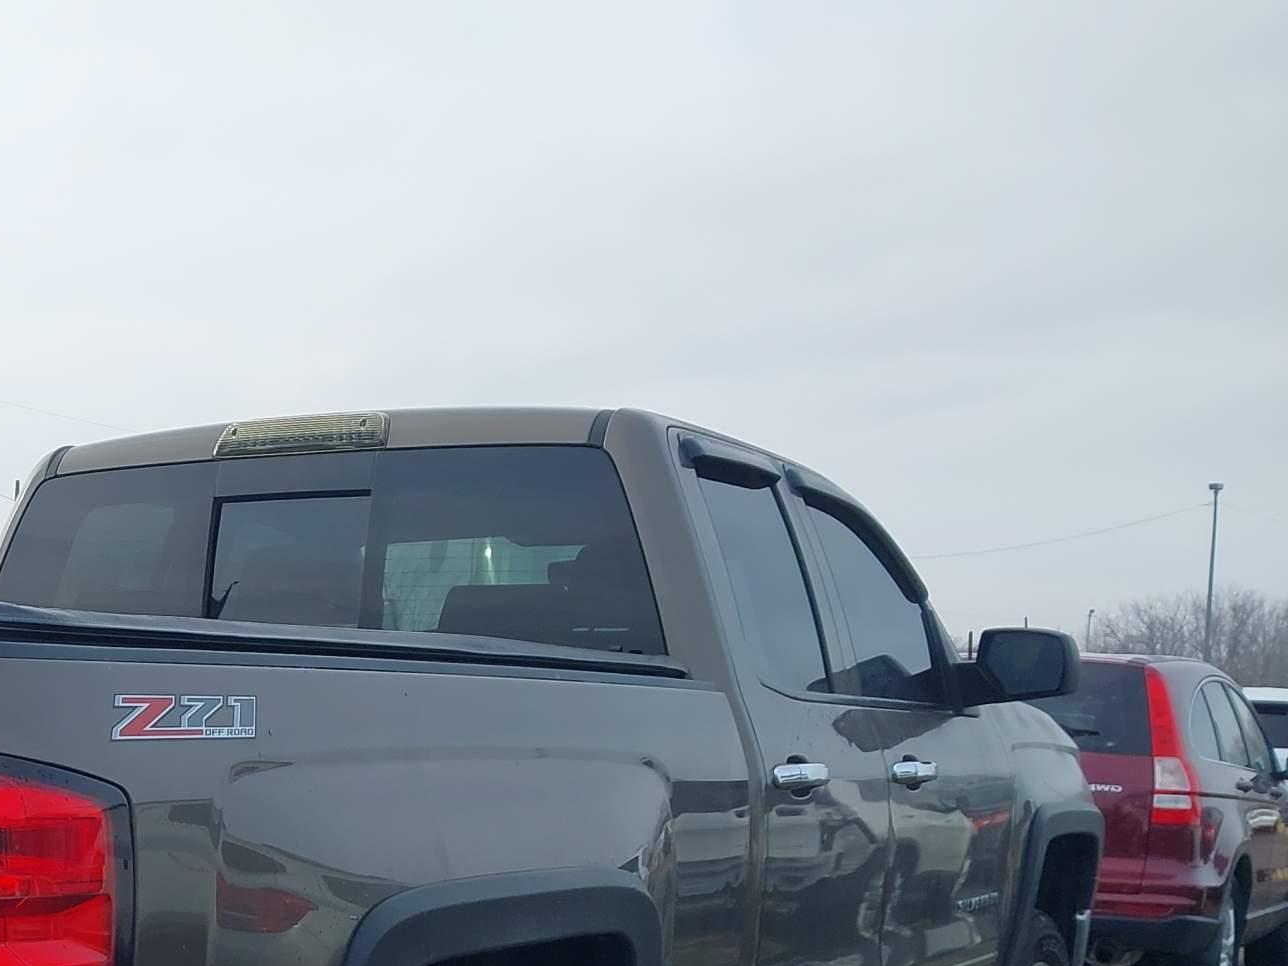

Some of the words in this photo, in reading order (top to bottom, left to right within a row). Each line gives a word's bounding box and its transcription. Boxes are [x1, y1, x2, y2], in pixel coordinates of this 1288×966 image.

[111, 693, 258, 740] Z71
[204, 728, 225, 737] OFF
[226, 728, 255, 737] ROAD
